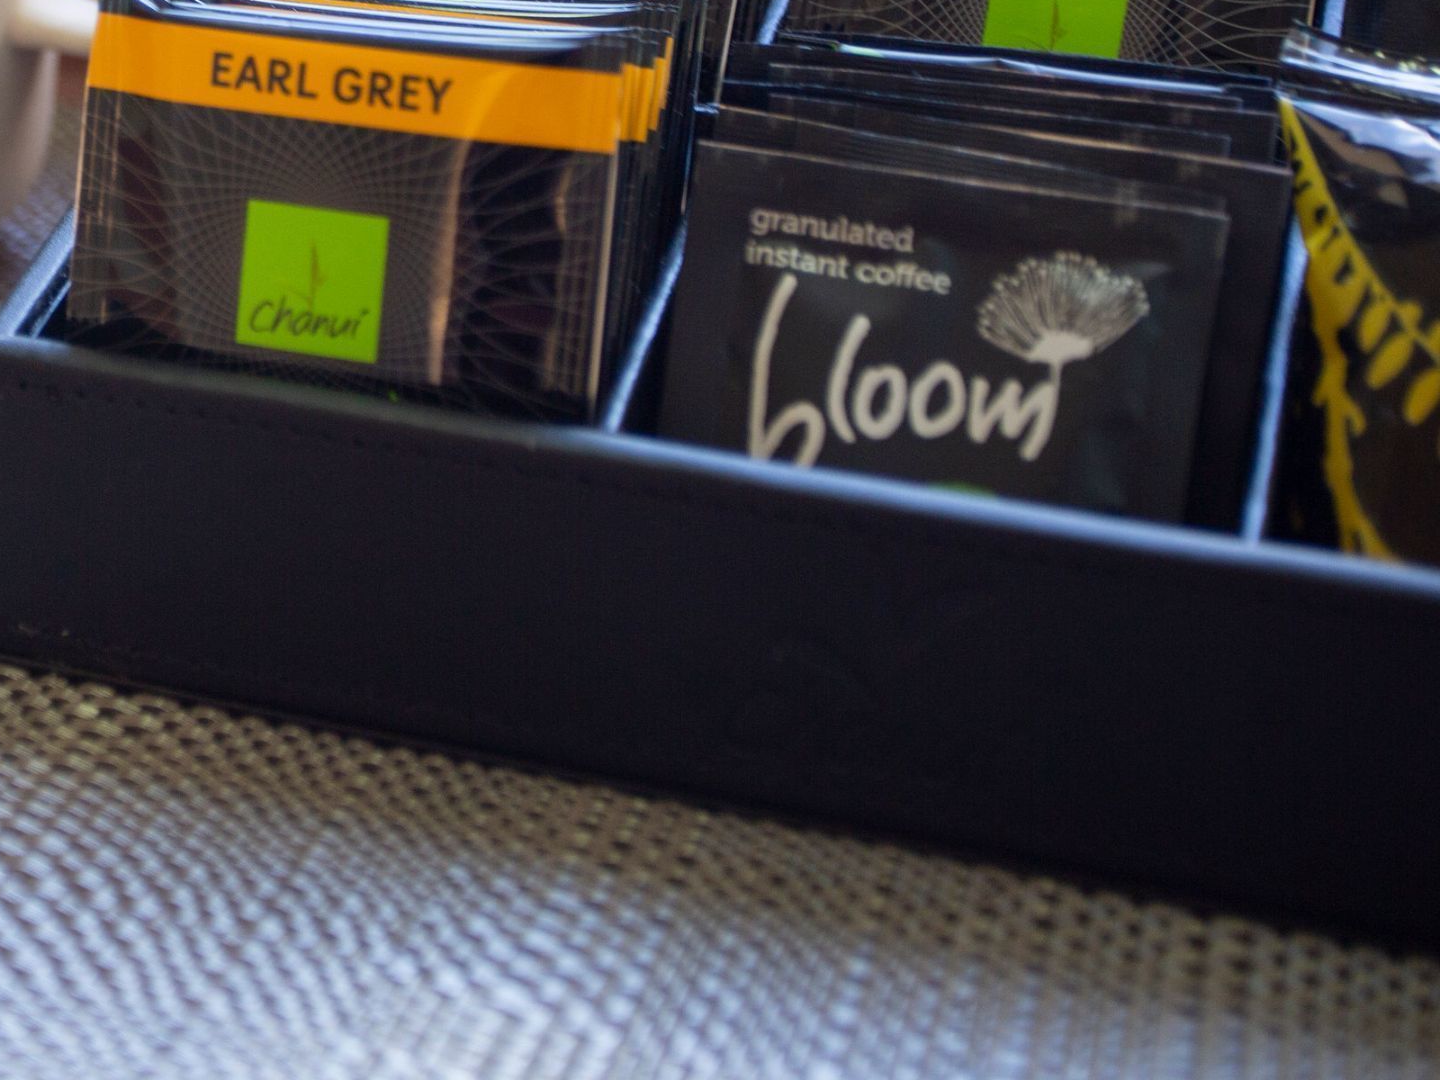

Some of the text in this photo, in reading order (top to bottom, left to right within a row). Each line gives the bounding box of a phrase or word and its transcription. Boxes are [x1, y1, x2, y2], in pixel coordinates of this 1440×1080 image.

[210, 52, 453, 115] EARL GREY
[750, 208, 916, 254] granulated
[746, 240, 952, 295] instant coffee
[748, 274, 1062, 469] bloom
